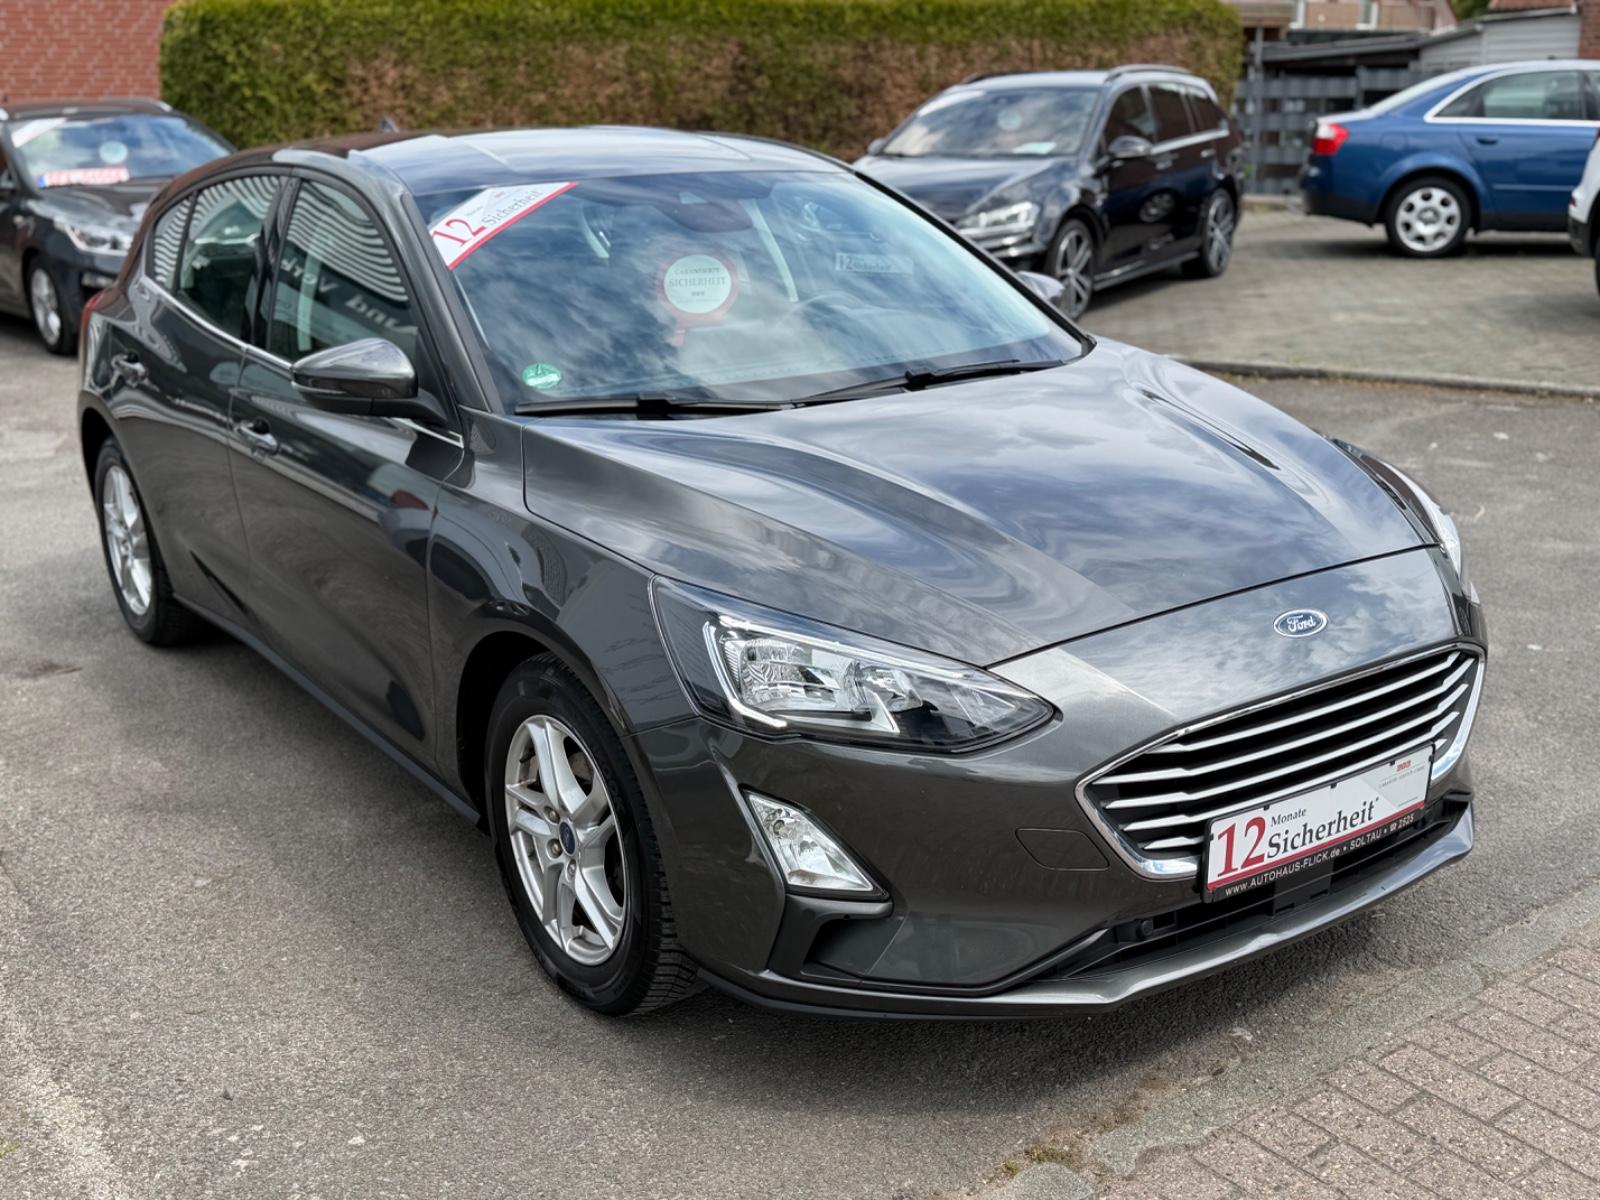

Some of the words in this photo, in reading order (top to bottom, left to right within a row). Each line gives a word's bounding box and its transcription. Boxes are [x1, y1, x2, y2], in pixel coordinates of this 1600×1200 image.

[432, 218, 486, 247] 12
[1286, 614, 1317, 633] Ford
[1271, 808, 1307, 828] Monate
[1216, 816, 1267, 878] 12
[1224, 847, 1341, 897] www.AUTOHAUS-FLICK.de
[1349, 829, 1383, 851] SOLTAU
